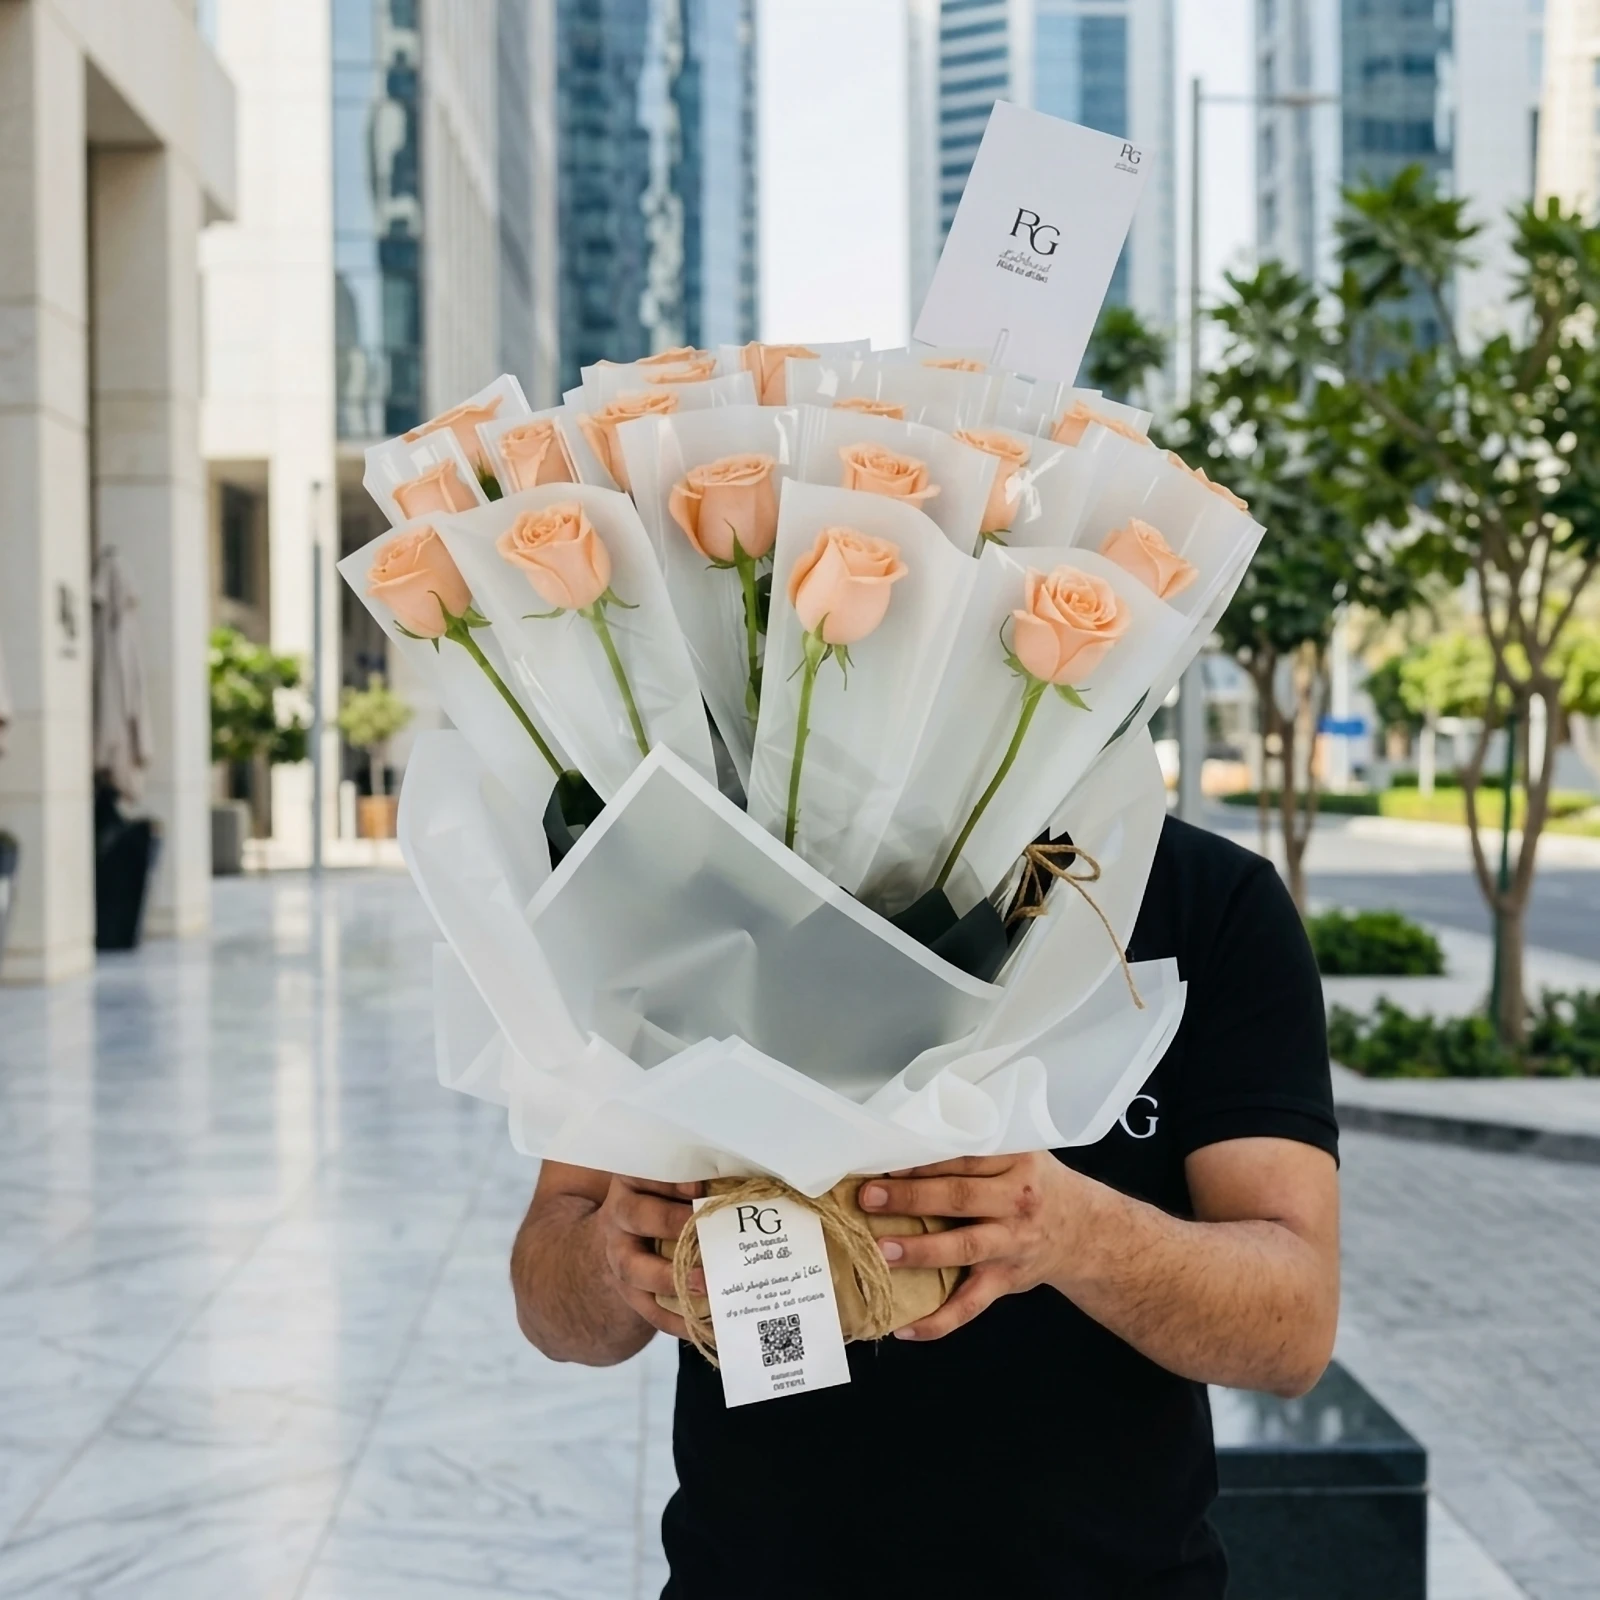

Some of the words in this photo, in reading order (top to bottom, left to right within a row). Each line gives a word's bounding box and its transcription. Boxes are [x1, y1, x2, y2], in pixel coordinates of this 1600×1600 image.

[1120, 143, 1141, 164] RG
[1009, 207, 1060, 255] RG
[1119, 1094, 1159, 1139] G
[736, 1205, 782, 1235] RG
